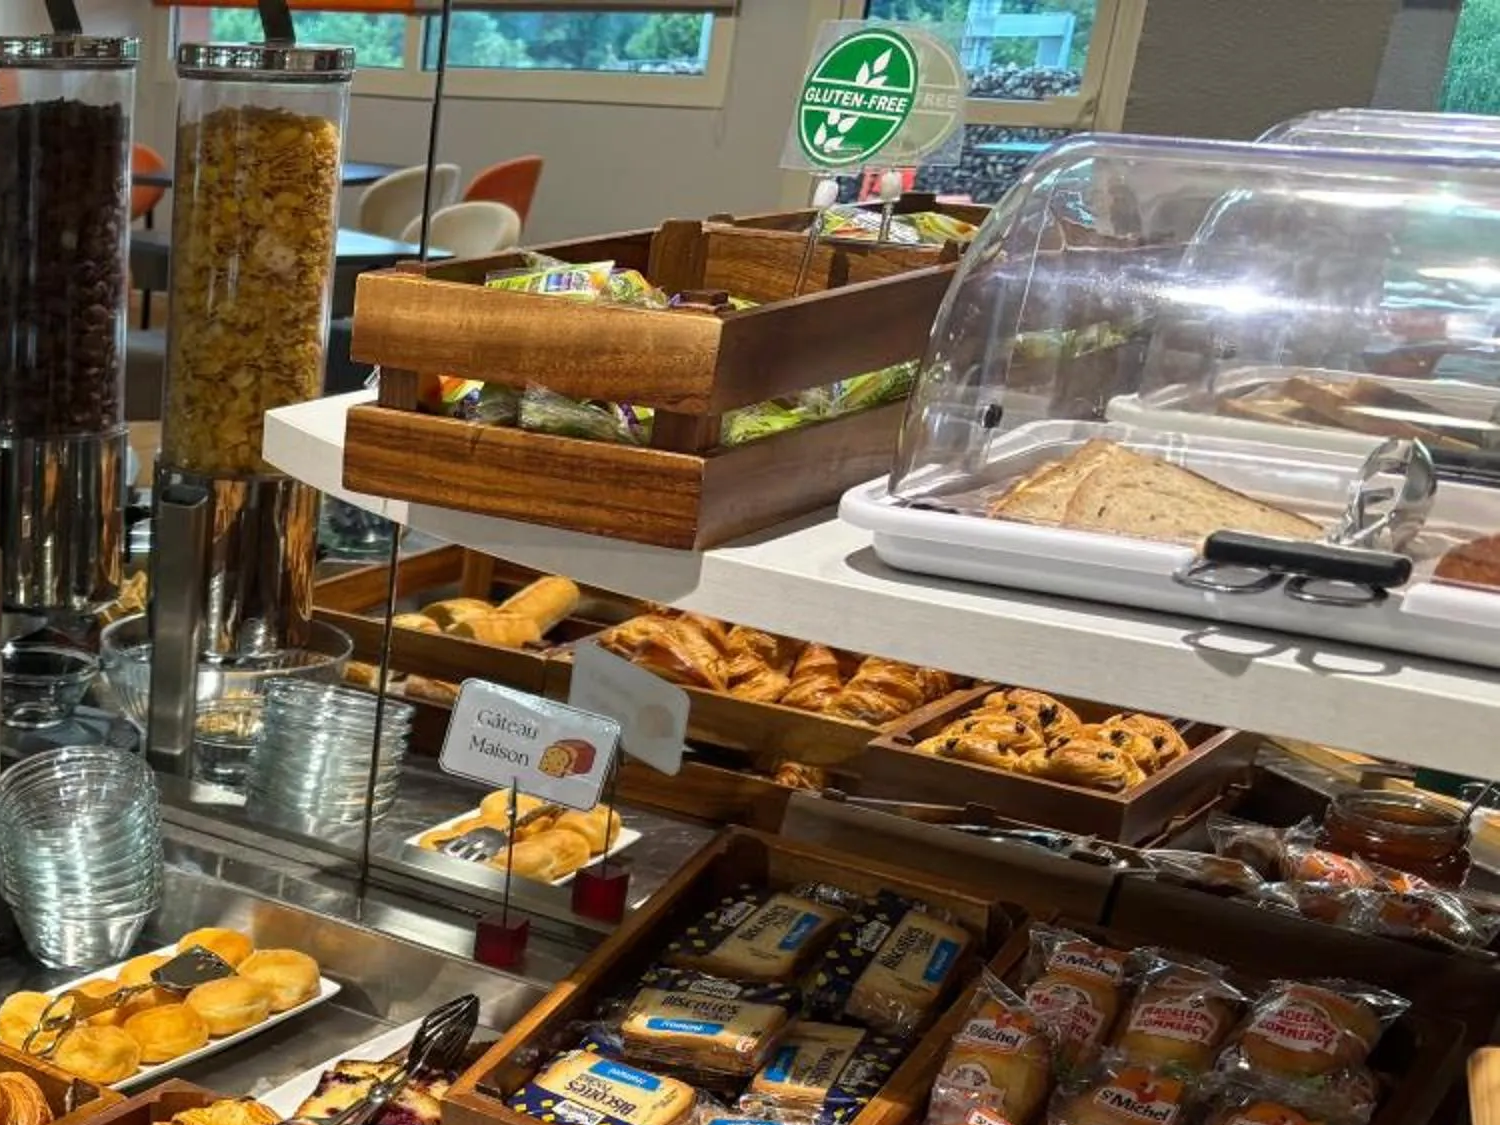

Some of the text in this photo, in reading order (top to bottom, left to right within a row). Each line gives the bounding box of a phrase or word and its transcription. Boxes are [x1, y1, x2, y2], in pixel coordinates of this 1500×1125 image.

[804, 87, 910, 113] GLUTEN-FREE
[476, 708, 539, 740] Gâteau
[468, 735, 530, 767] Maison
